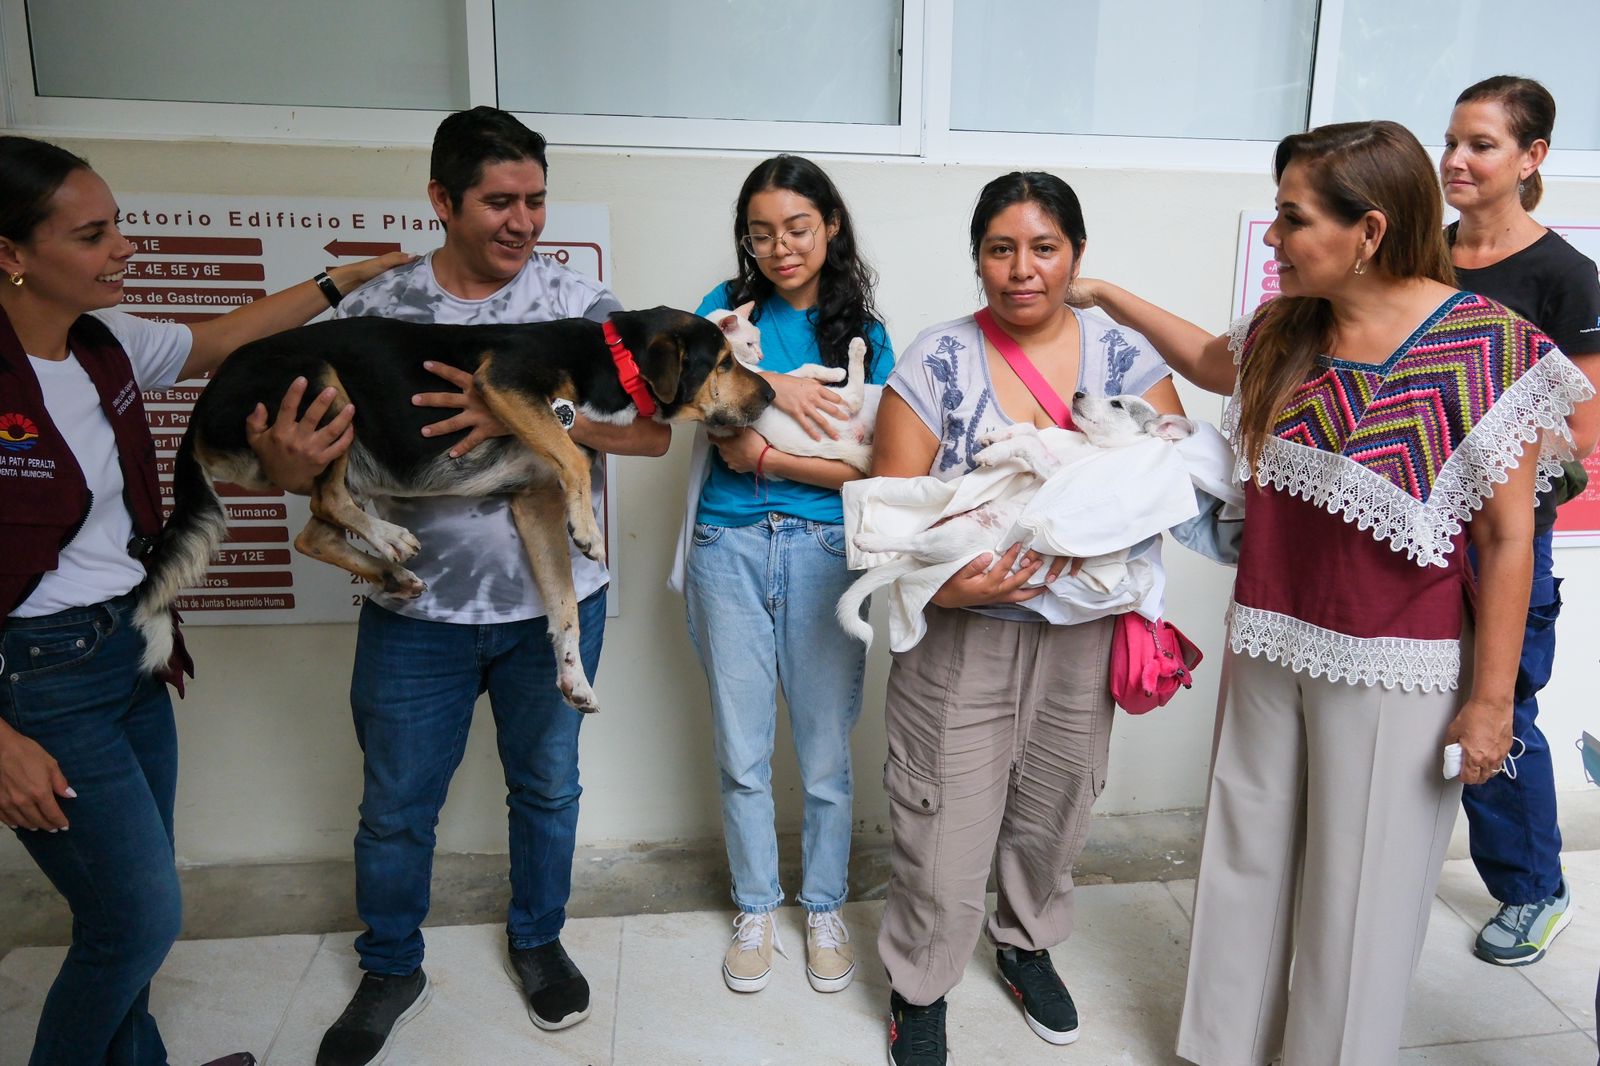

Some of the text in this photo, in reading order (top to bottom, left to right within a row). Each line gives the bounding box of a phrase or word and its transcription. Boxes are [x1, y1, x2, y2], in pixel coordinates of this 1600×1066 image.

[229, 211, 340, 228] Edificio
[352, 213, 366, 230] E
[383, 214, 440, 231] Plan
[142, 239, 161, 251] 1E
[144, 263, 167, 277] 4E,
[170, 264, 188, 276] 5E
[191, 266, 200, 278] y
[203, 264, 221, 276] 6E
[146, 292, 163, 303] de
[167, 292, 254, 305] Gastronomía
[157, 415, 165, 426] y
[8, 456, 26, 467] PATY
[27, 458, 56, 470] PERALTA
[230, 553, 238, 564] y
[241, 551, 265, 562] 12E
[190, 598, 199, 608] de
[200, 598, 225, 608] Juntas
[226, 597, 263, 608] Desarrollo
[263, 597, 285, 607] Huma
